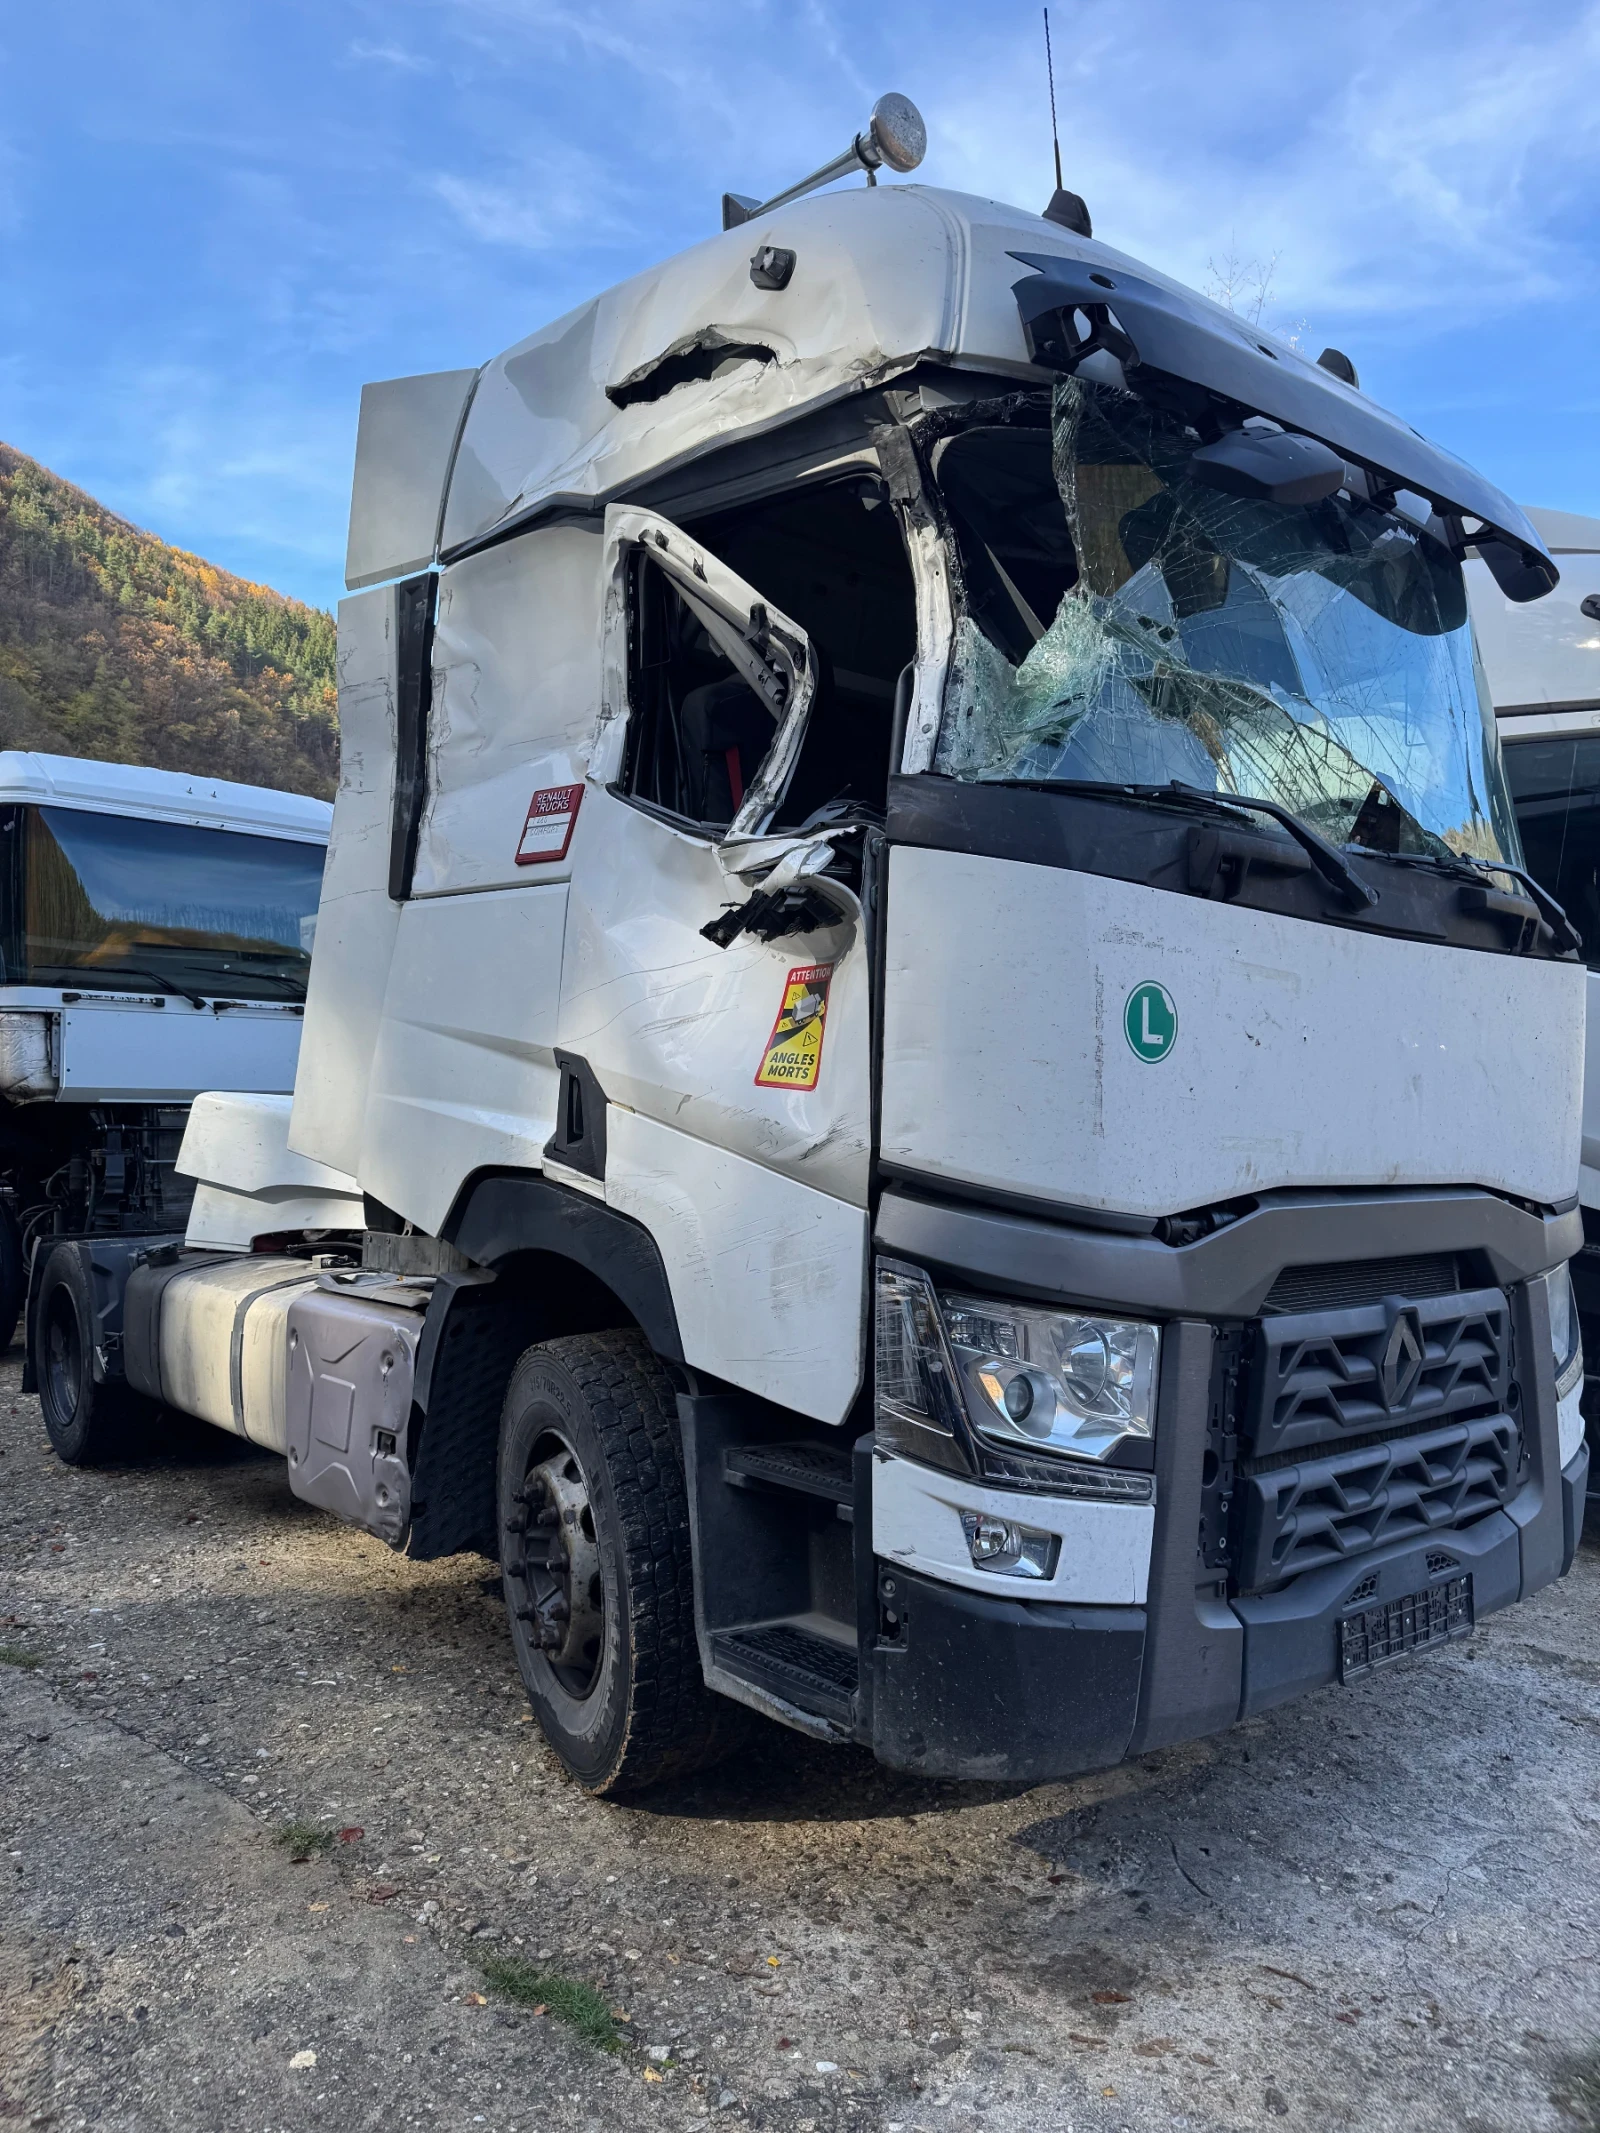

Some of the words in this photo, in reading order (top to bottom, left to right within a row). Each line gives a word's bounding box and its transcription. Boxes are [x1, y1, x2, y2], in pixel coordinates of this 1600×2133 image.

[537, 789, 573, 804] RENAULT
[536, 800, 570, 813] TRUCKS
[790, 967, 832, 982] ATTENTION
[1141, 996, 1164, 1045] L
[770, 1051, 815, 1066] ANGLES
[767, 1065, 810, 1079] MORTS
